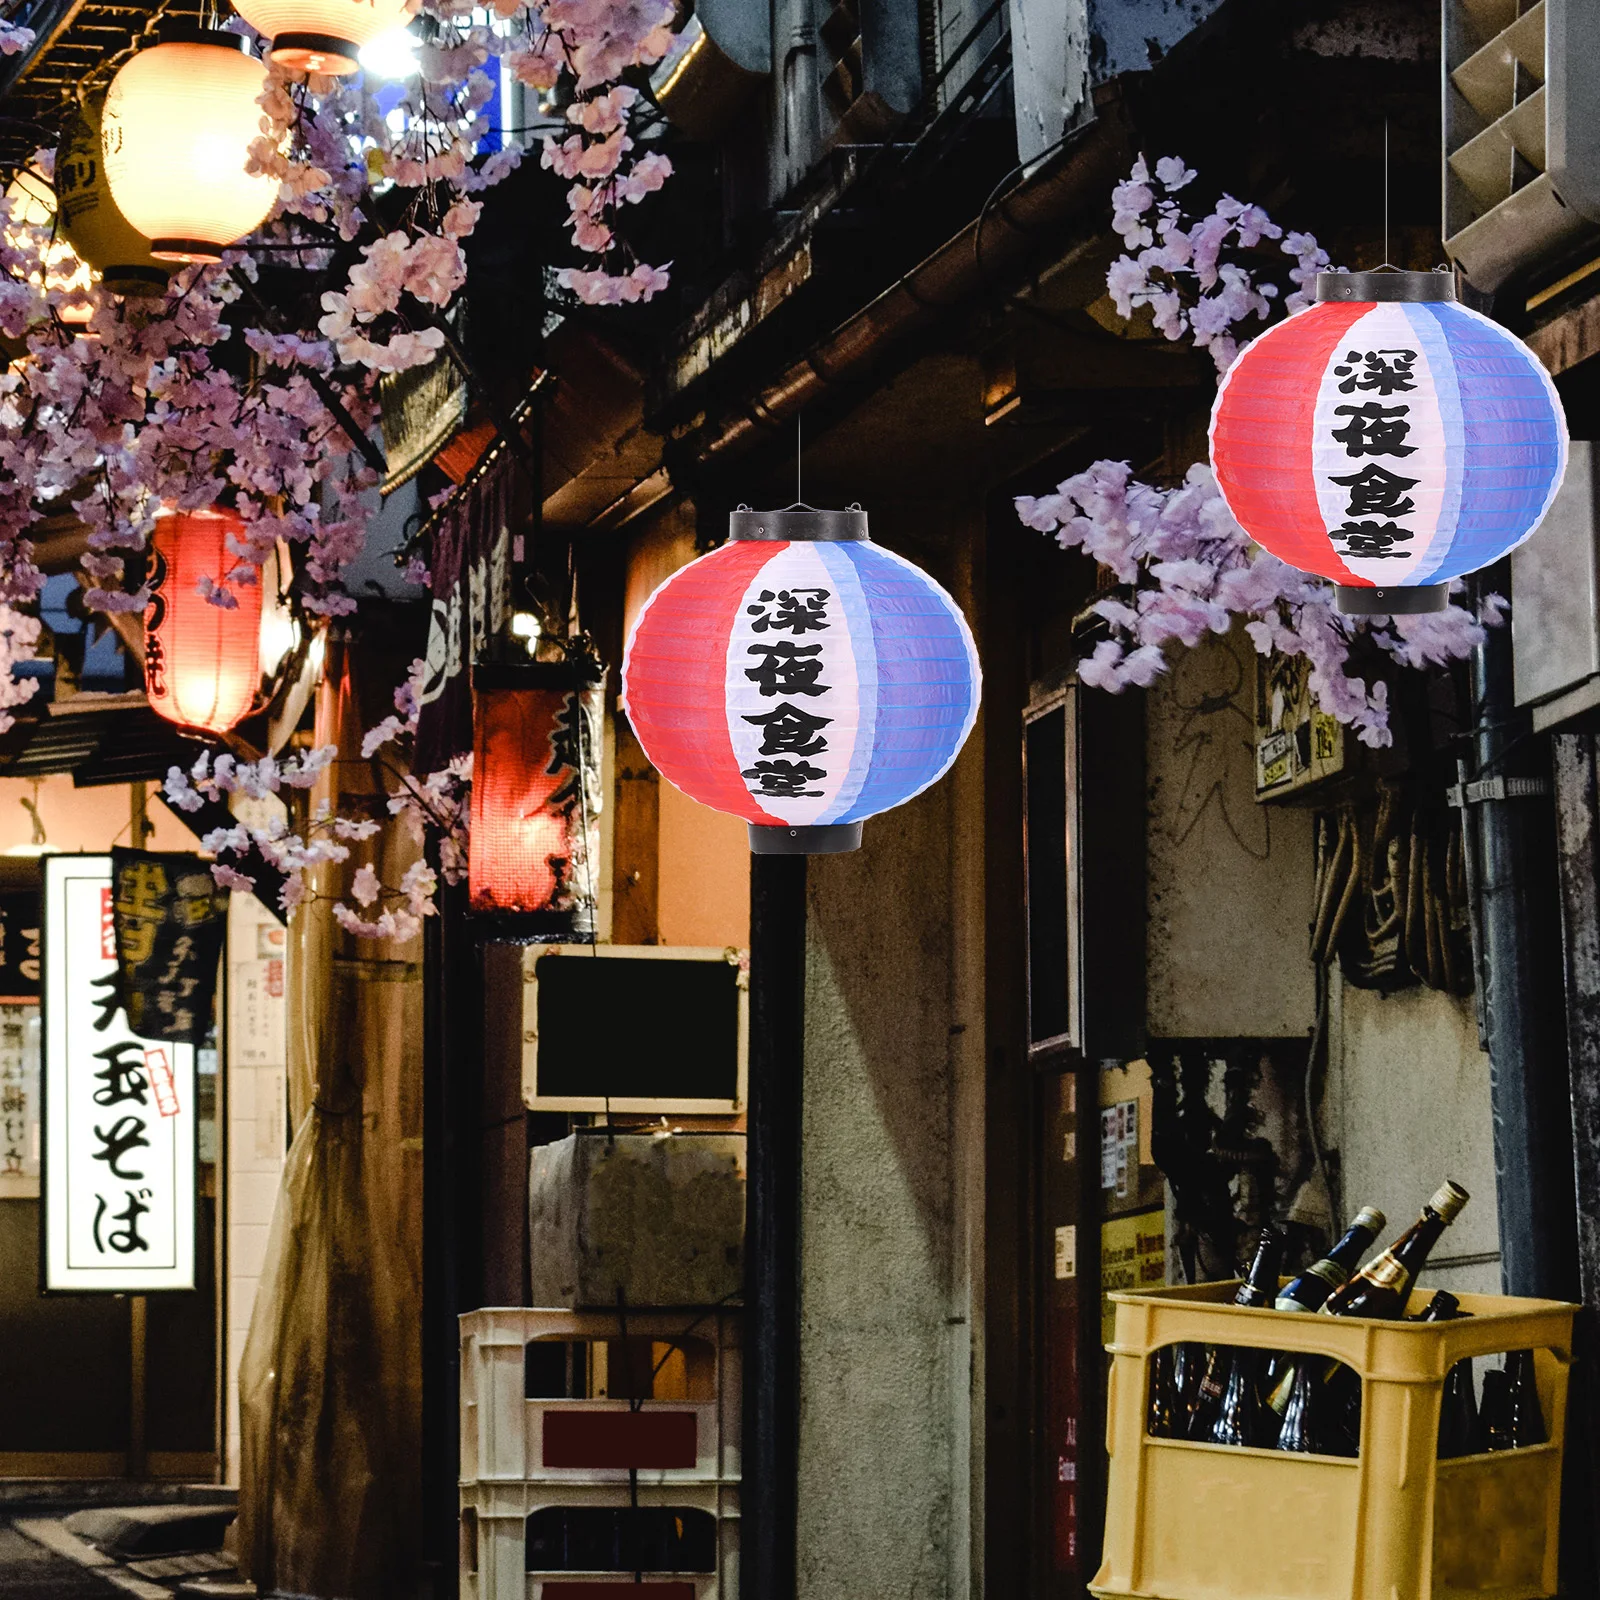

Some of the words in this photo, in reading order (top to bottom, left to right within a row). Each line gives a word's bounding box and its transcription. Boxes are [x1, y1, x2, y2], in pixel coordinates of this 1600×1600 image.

[1328, 349, 1421, 559] 深夜食堂
[741, 588, 834, 798] 深夜食堂
